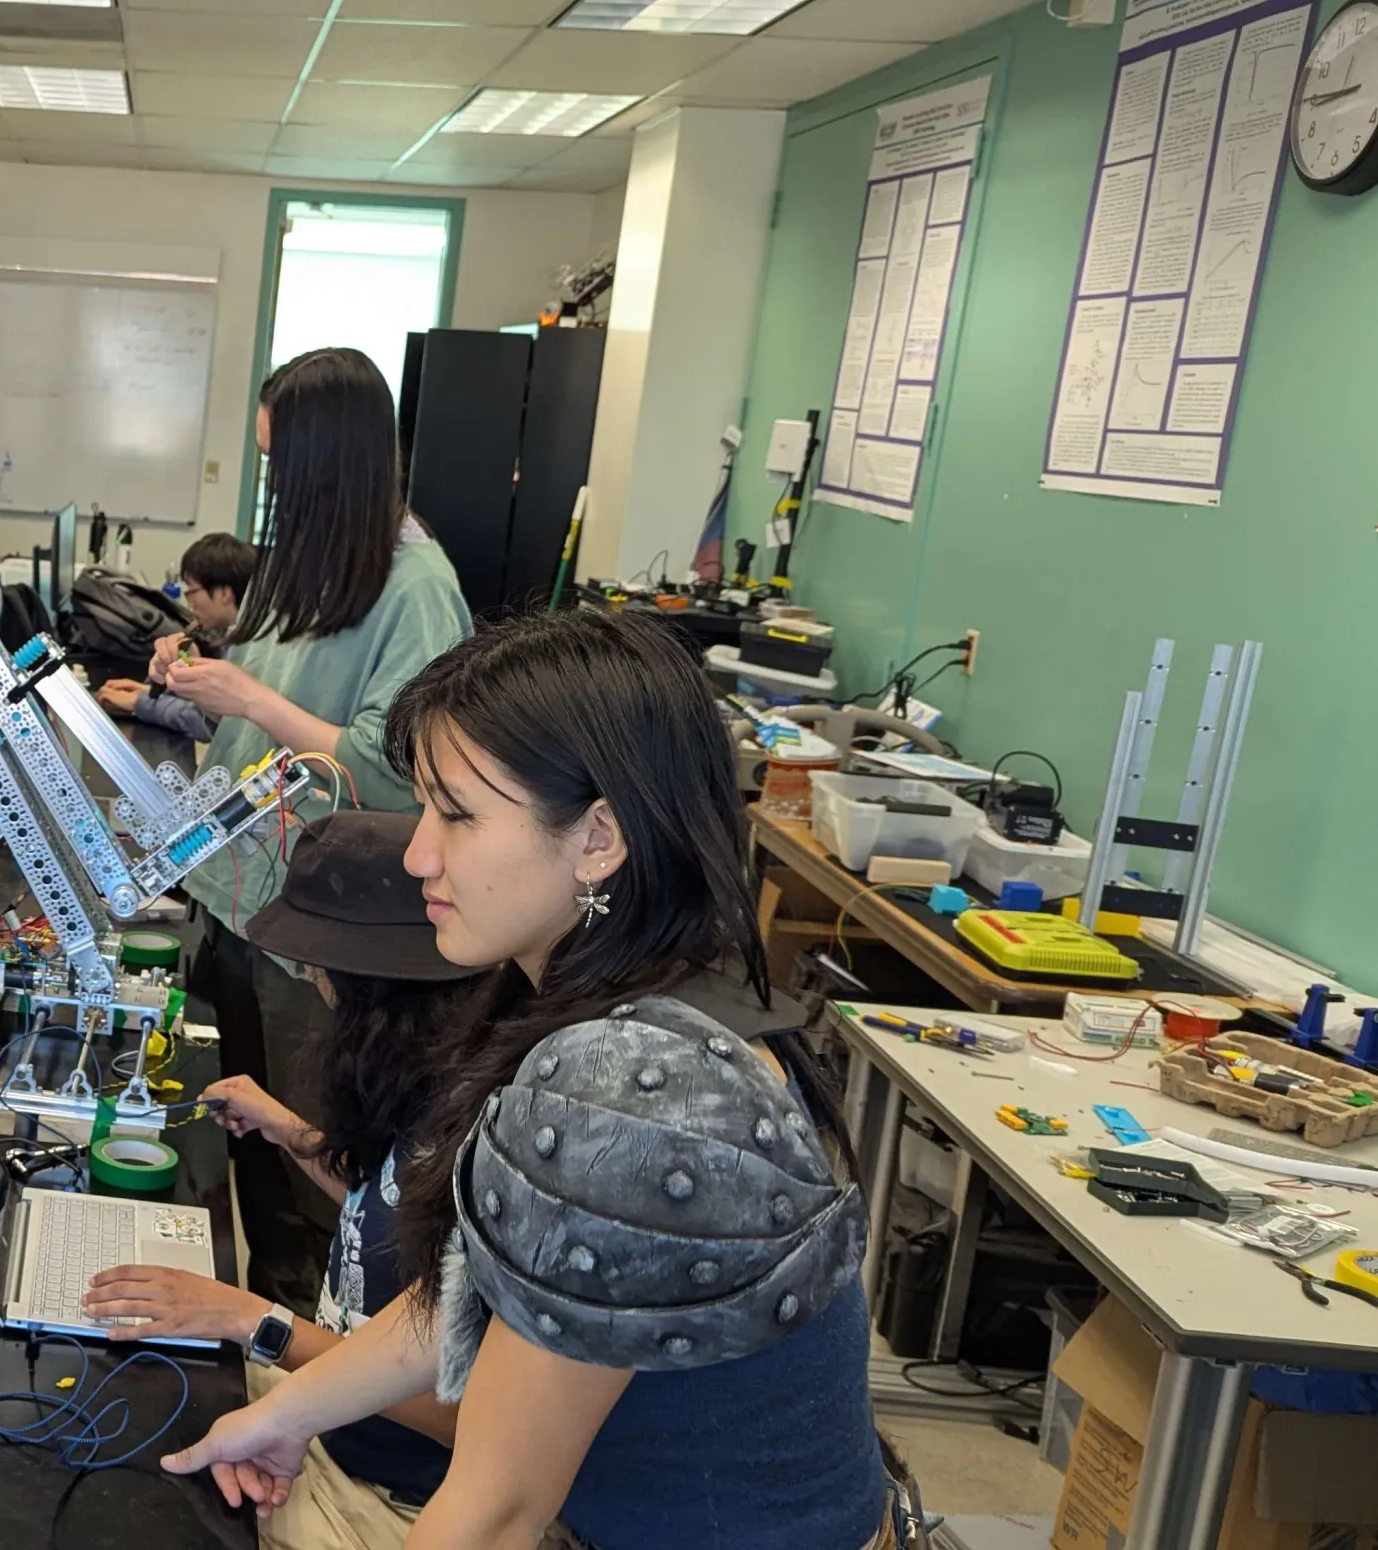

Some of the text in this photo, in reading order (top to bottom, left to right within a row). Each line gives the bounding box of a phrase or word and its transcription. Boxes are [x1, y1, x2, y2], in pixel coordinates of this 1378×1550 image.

[1355, 17, 1366, 35] 12
[1336, 31, 1346, 49] 11
[1318, 61, 1330, 80] 10
[1308, 120, 1317, 138] 8
[1316, 142, 1325, 160] 7
[1352, 135, 1361, 153] 5
[1330, 149, 1339, 166] 6
